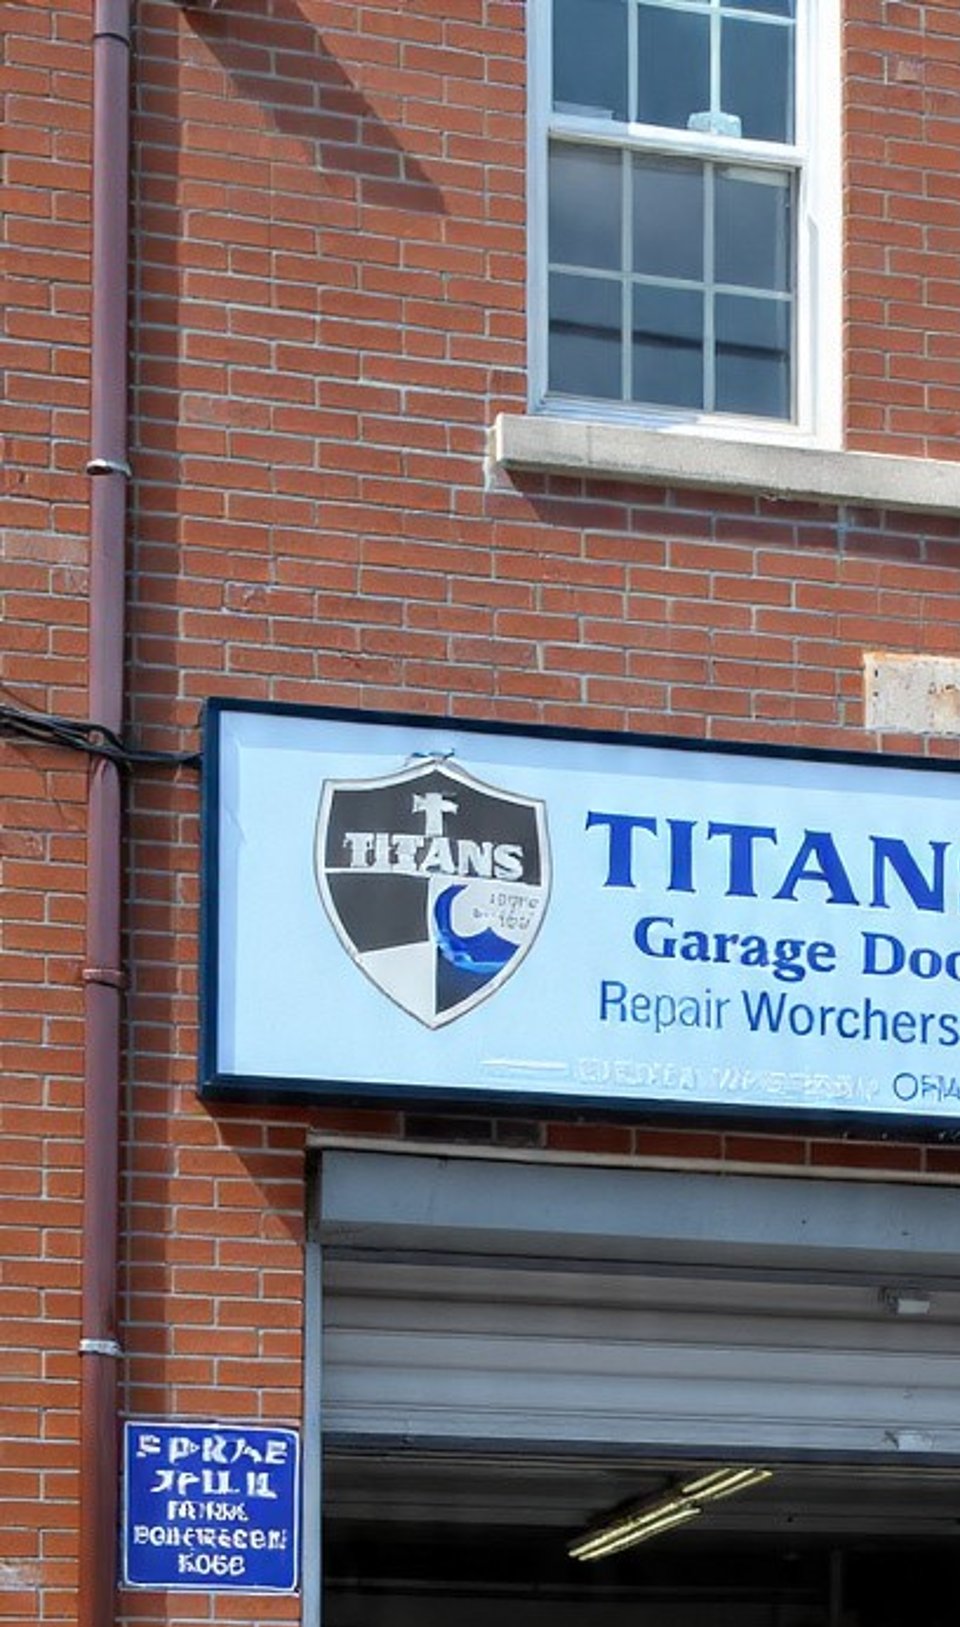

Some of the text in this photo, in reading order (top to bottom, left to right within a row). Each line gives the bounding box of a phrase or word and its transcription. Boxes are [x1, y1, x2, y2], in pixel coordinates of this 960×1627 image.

[343, 832, 524, 881] TITANS
[633, 916, 838, 982] Garage
[600, 979, 731, 1036] Repair
